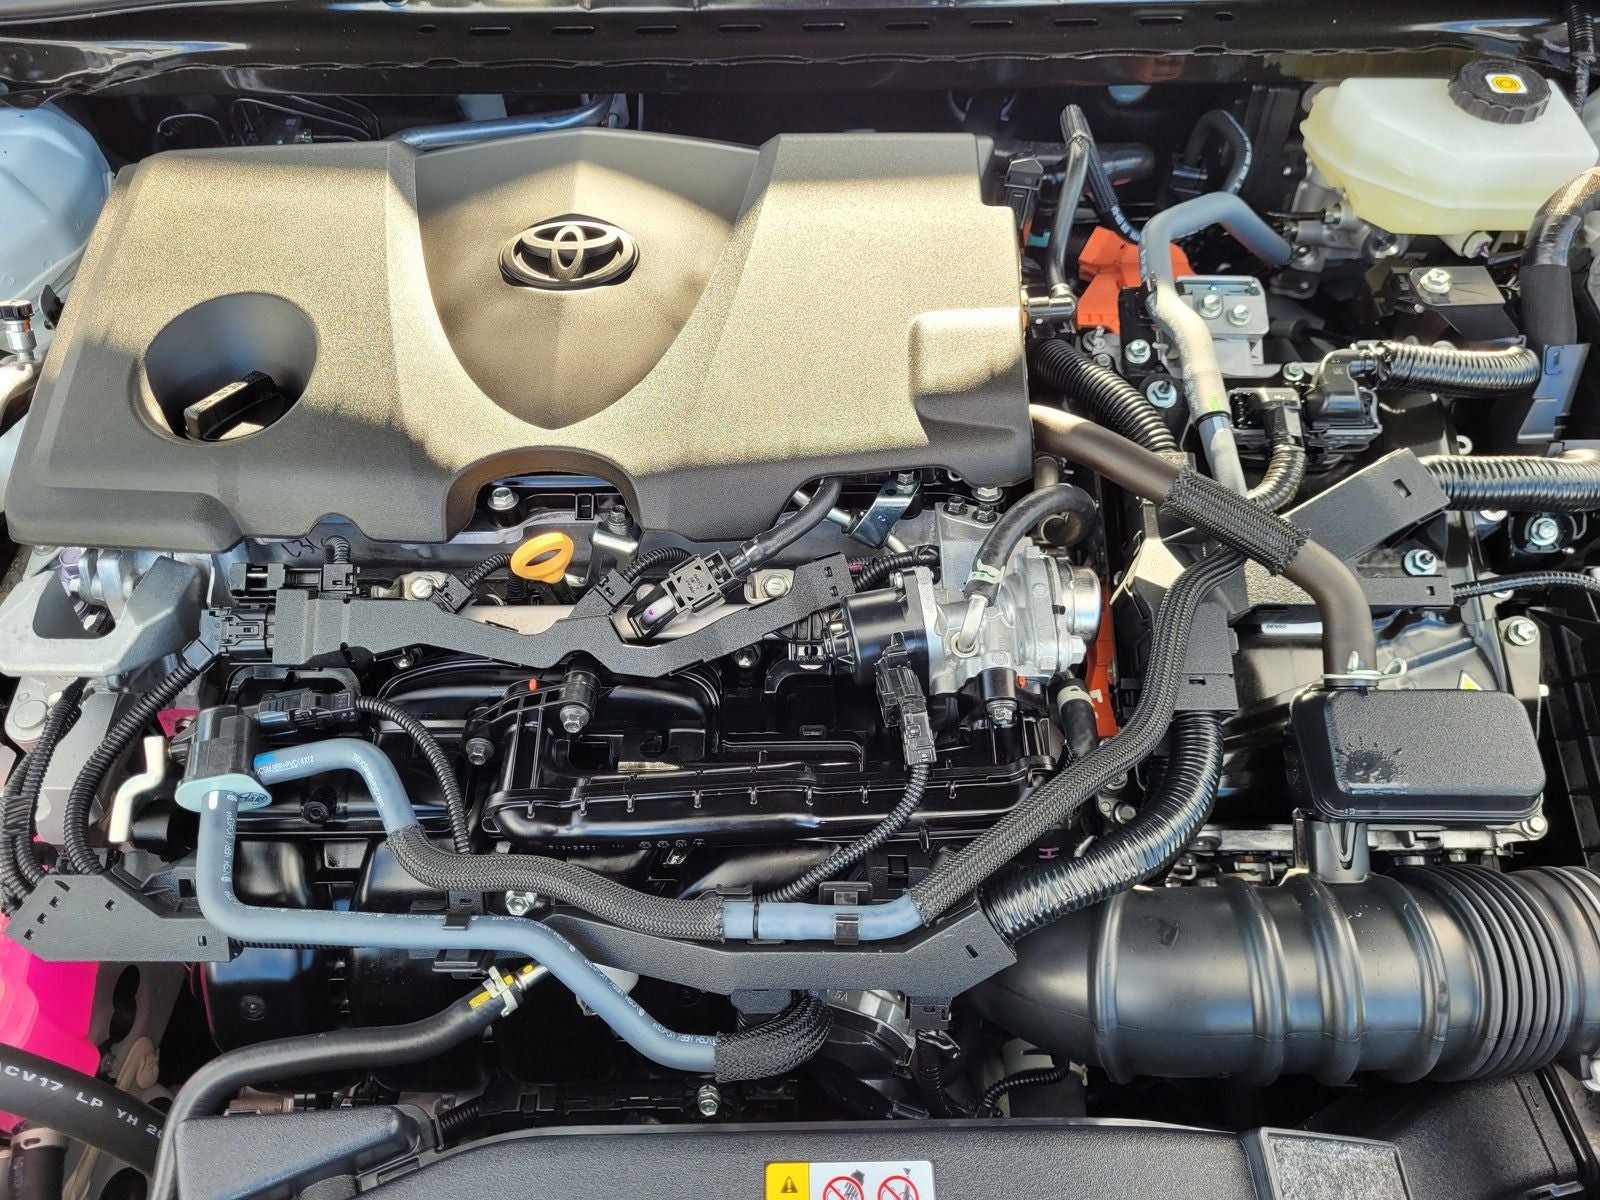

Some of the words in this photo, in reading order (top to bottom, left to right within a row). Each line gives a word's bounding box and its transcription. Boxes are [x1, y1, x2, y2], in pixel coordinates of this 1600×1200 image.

[0, 1062, 64, 1091] CV17
[76, 1091, 104, 1107] LP
[116, 1107, 139, 1126] YH
